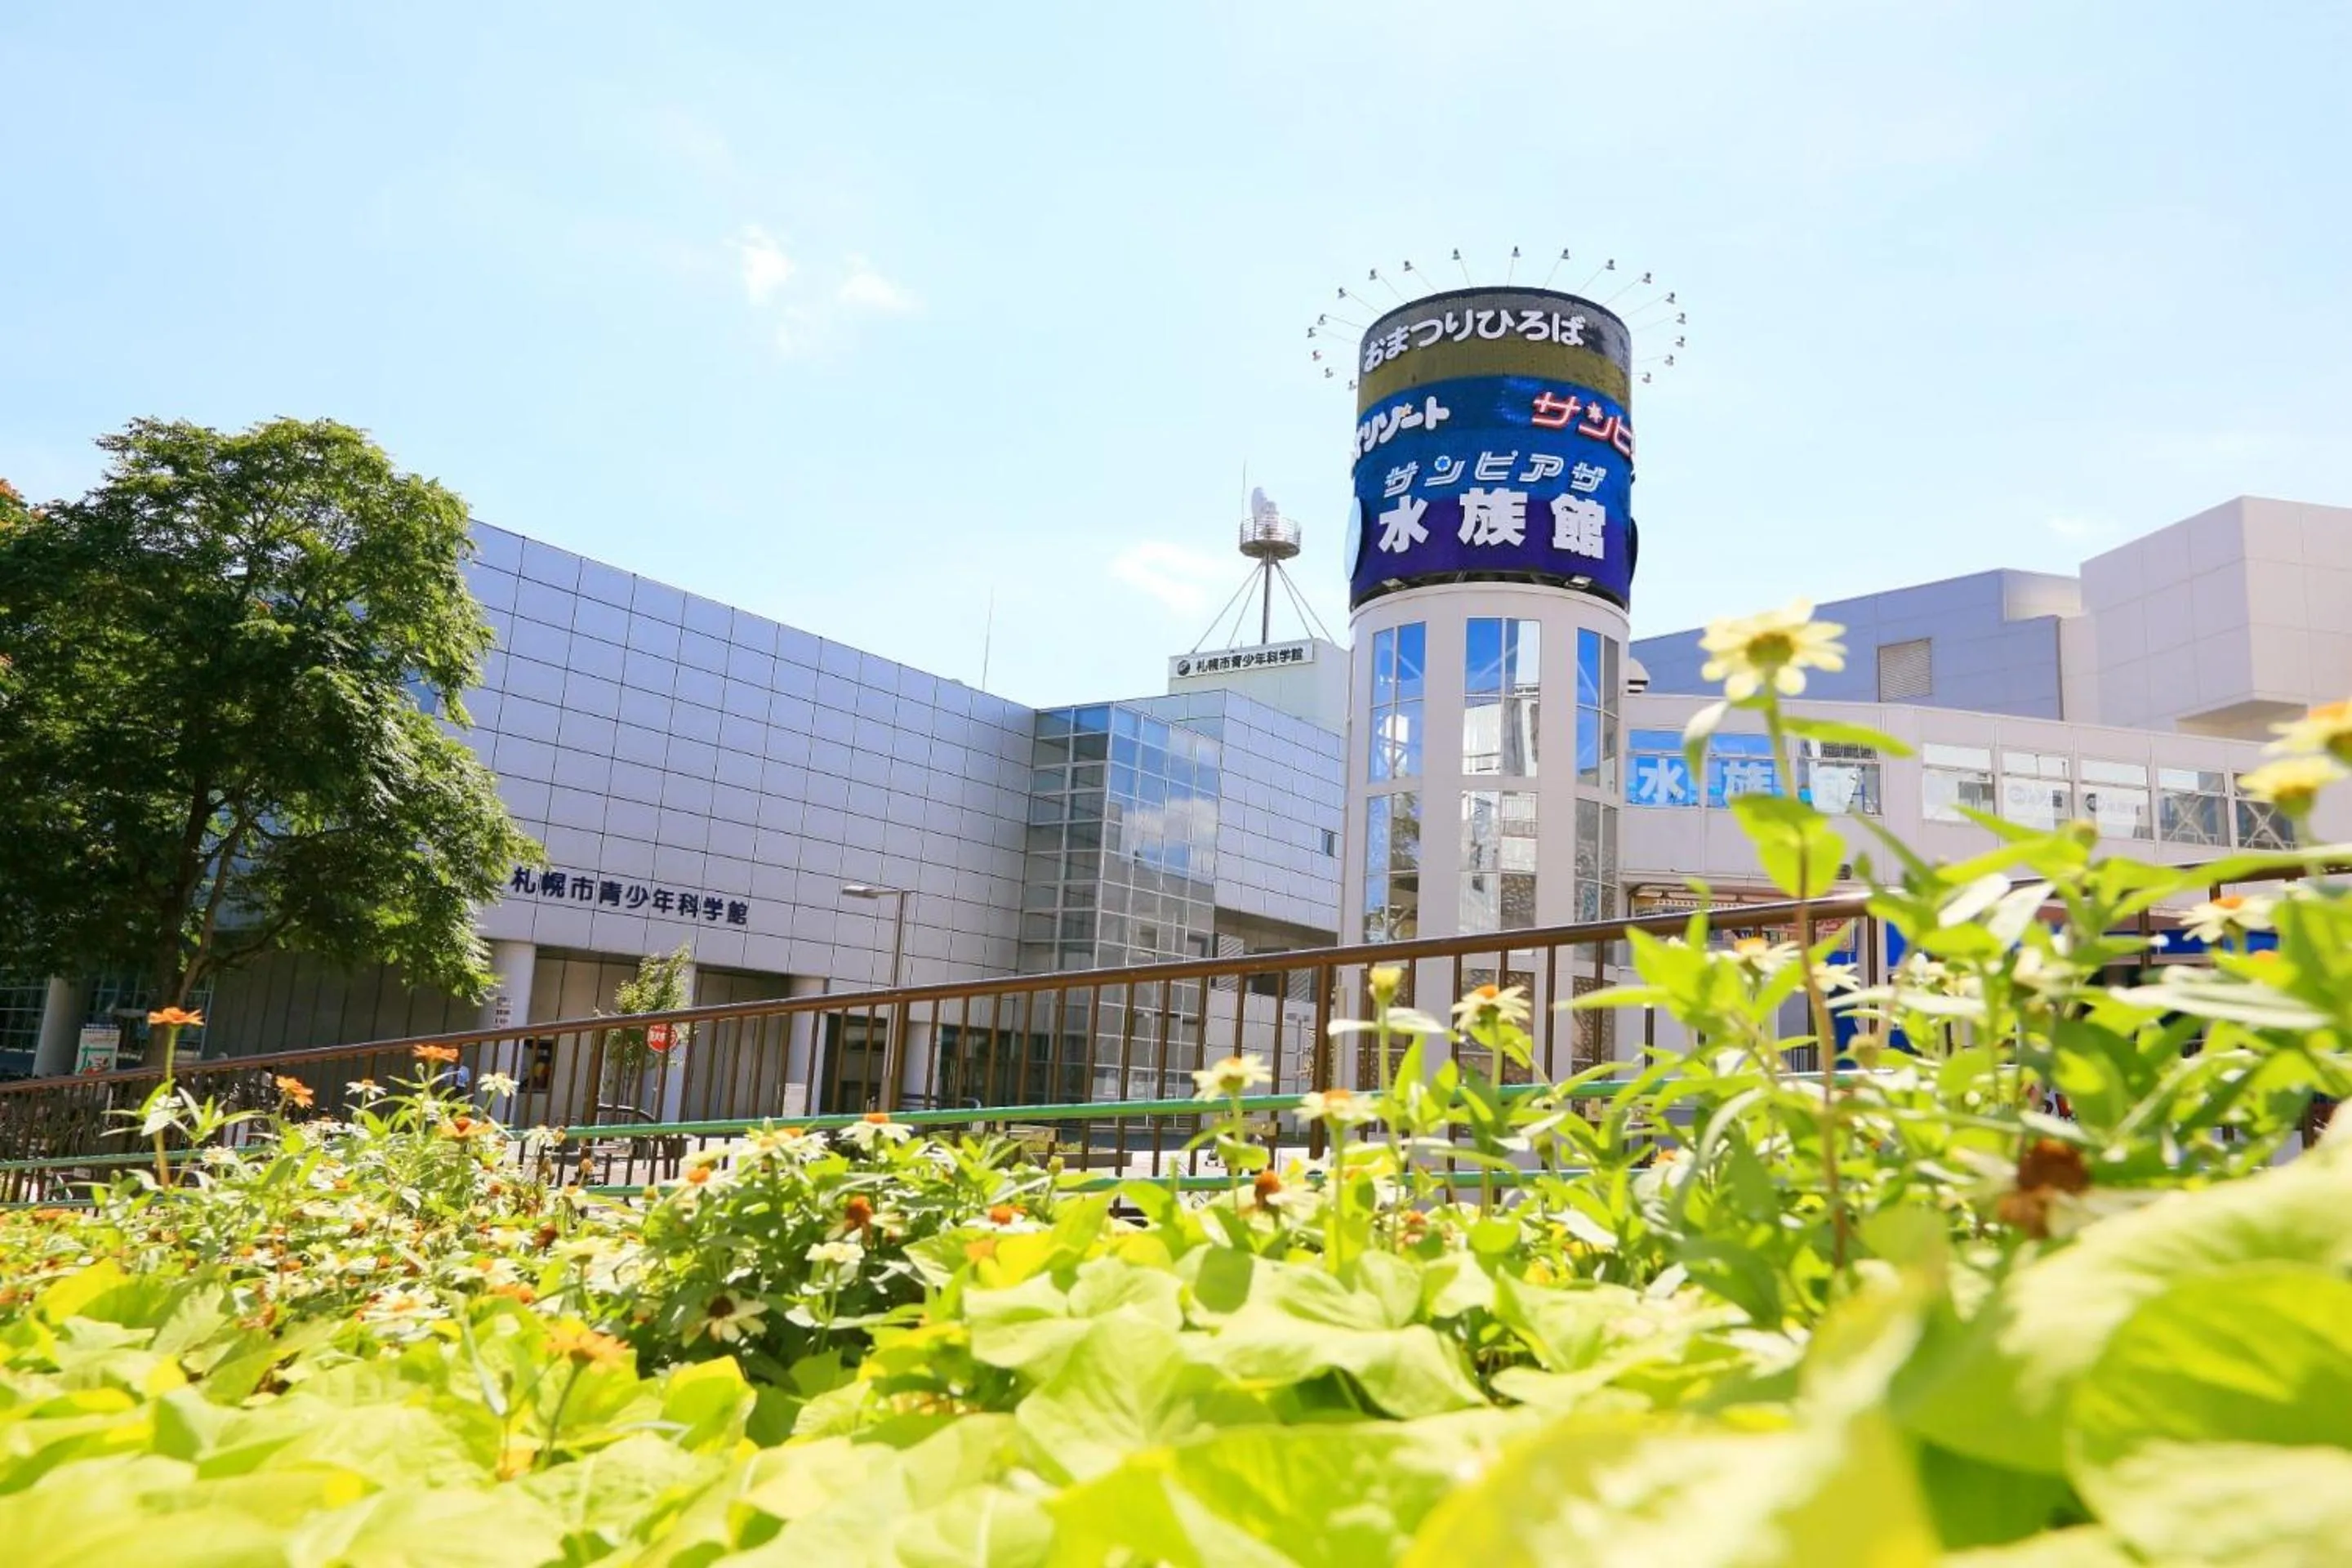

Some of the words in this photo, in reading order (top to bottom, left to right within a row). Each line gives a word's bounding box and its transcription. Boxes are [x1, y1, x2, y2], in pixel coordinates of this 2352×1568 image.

[1363, 309, 1585, 373] おまつりひろば
[1384, 450, 1607, 497] サンピアザ
[1379, 488, 1606, 559] 水族館
[1196, 647, 1303, 673] 札幌市青少年科学館
[510, 866, 749, 926] 札幌市青少年科学館
